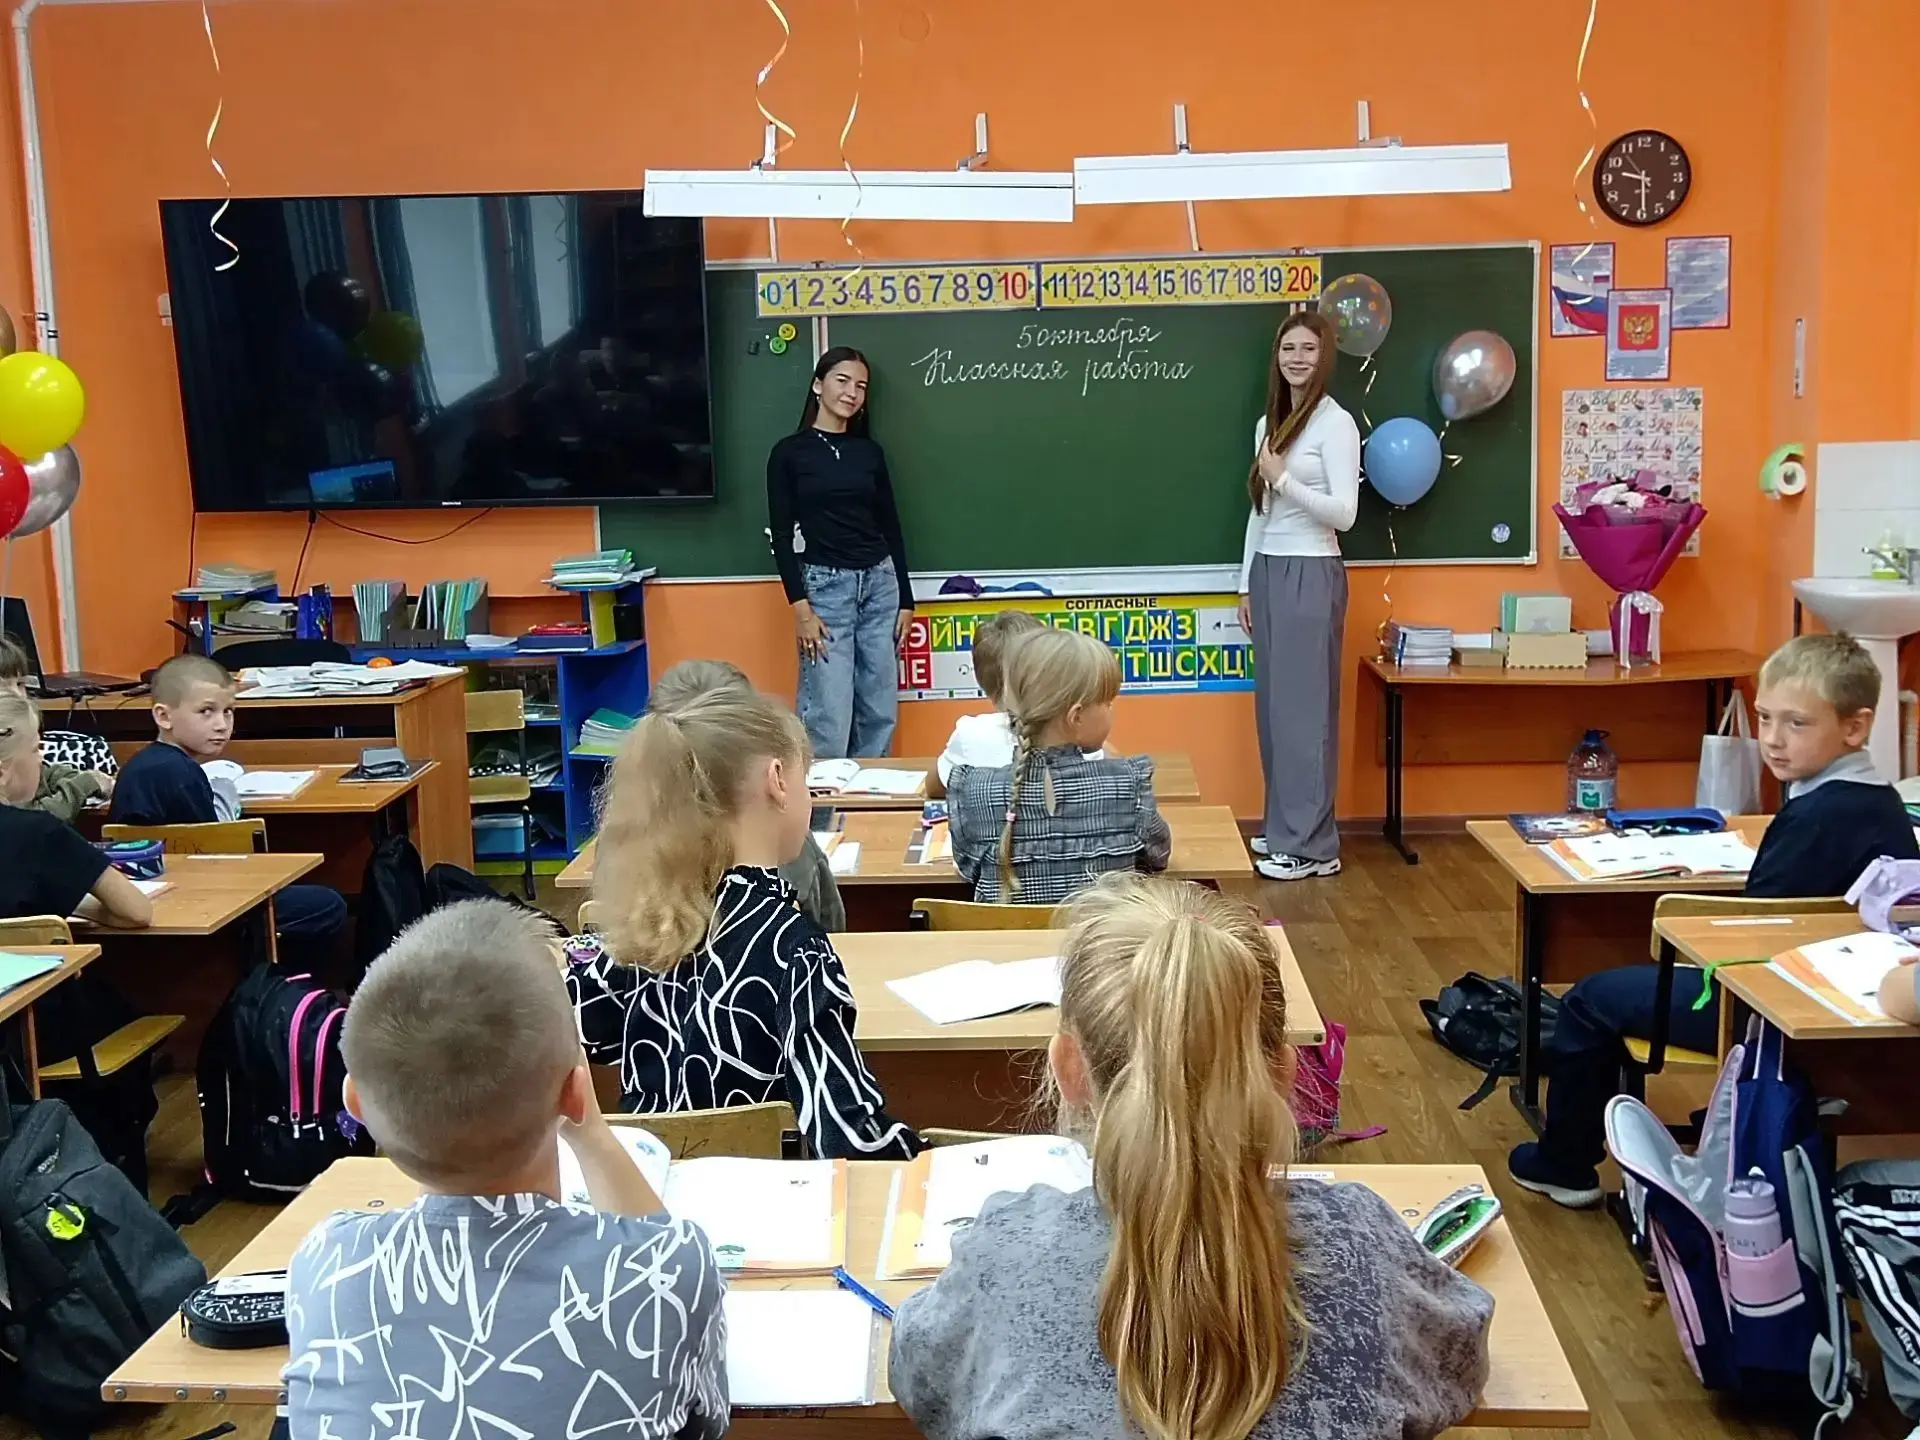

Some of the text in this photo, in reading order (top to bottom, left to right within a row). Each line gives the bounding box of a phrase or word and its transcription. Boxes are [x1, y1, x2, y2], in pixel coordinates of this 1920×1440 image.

[1621, 142, 1633, 153] 11
[1638, 136, 1652, 147] 12
[1660, 141, 1666, 152] 1
[1608, 157, 1622, 168] 10
[1669, 154, 1680, 166] 2
[1602, 173, 1613, 185] 9
[1673, 172, 1683, 183] 3
[1607, 190, 1618, 202] 8
[1666, 190, 1675, 201] 4
[1621, 204, 1630, 216] 7
[1636, 208, 1647, 220] 6
[1654, 203, 1664, 214] 5
[1050, 266, 1312, 298] 11 12 13 14 15 16 17 18 19 20
[767, 271, 1027, 307] 0 1 2 3 4 5 6 7 8 9 10
[1036, 318, 1162, 358] октября
[911, 348, 1194, 396] Классная работа
[1065, 597, 1157, 610] СОГЛАСНЫЕ
[908, 622, 927, 648] Э
[932, 618, 953, 647] Й
[955, 621, 975, 646] Н
[1104, 617, 1118, 642] Г
[1125, 616, 1146, 644] Д
[1149, 615, 1171, 640] Ж
[1176, 615, 1192, 639] З
[912, 650, 1244, 684] Е Т Ш С Х Ц
